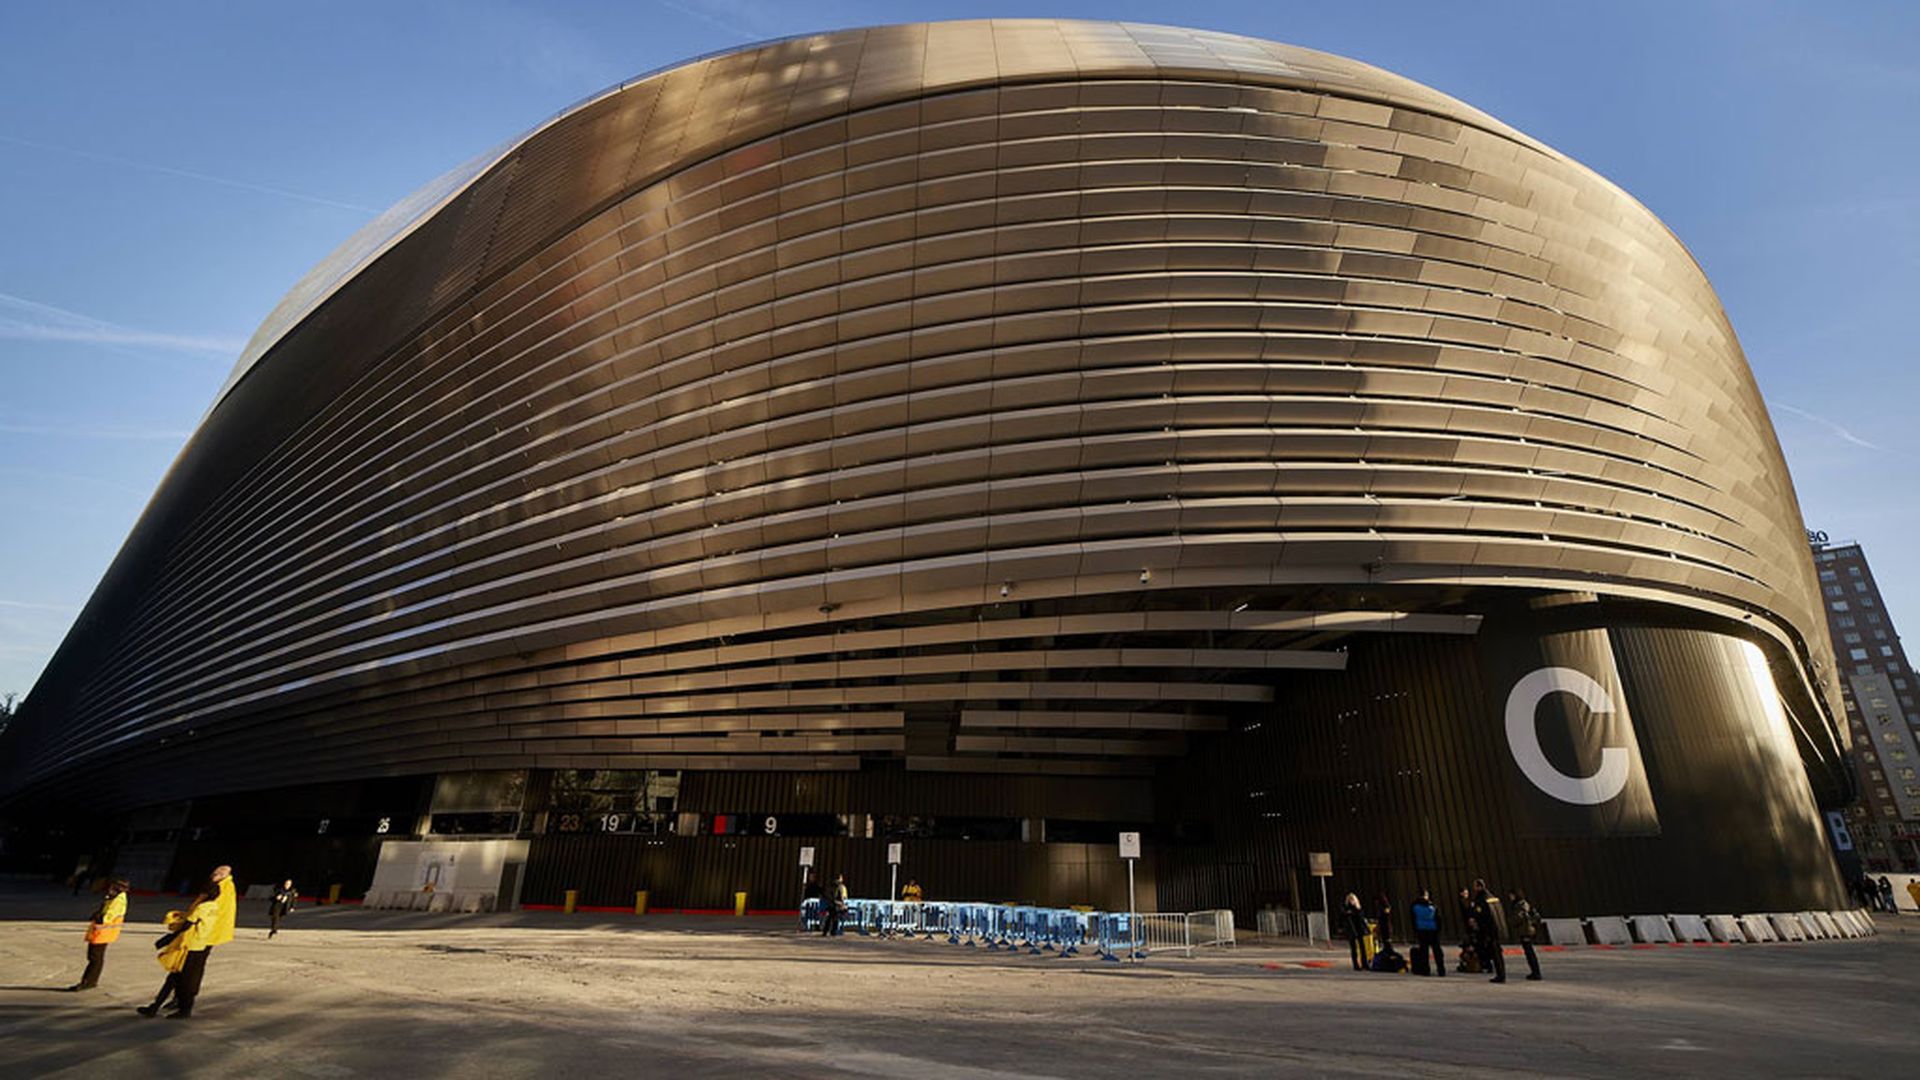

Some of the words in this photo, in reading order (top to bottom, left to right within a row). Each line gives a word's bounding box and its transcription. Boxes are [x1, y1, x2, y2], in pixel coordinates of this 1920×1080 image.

[1505, 667, 1630, 805] C
[600, 815, 620, 832] 19
[764, 816, 777, 834] 9
[1826, 811, 1853, 851] B
